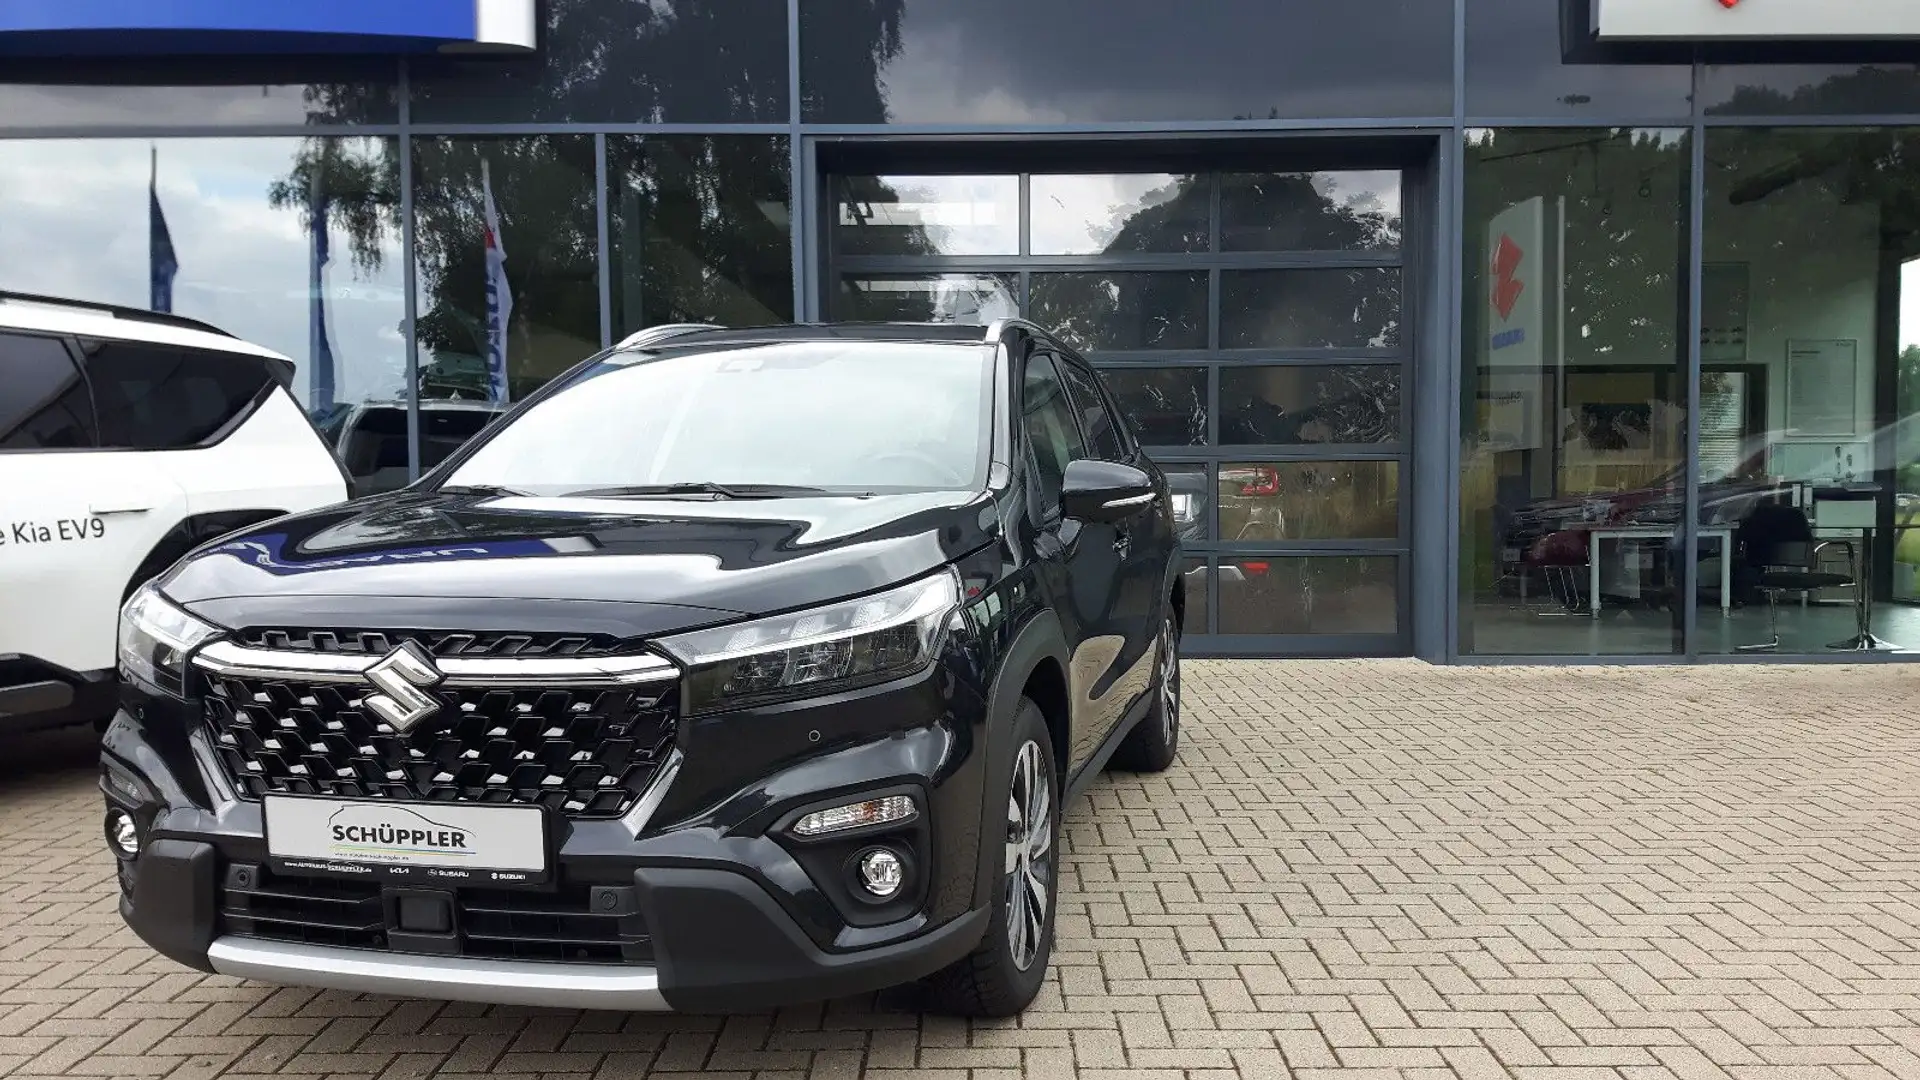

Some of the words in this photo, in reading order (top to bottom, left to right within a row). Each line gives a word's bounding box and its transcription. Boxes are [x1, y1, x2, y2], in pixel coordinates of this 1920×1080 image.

[11, 521, 51, 544] Kia
[57, 517, 105, 540] EV9
[332, 823, 467, 848] SCHÜPPLER
[438, 870, 470, 878] SUBARU
